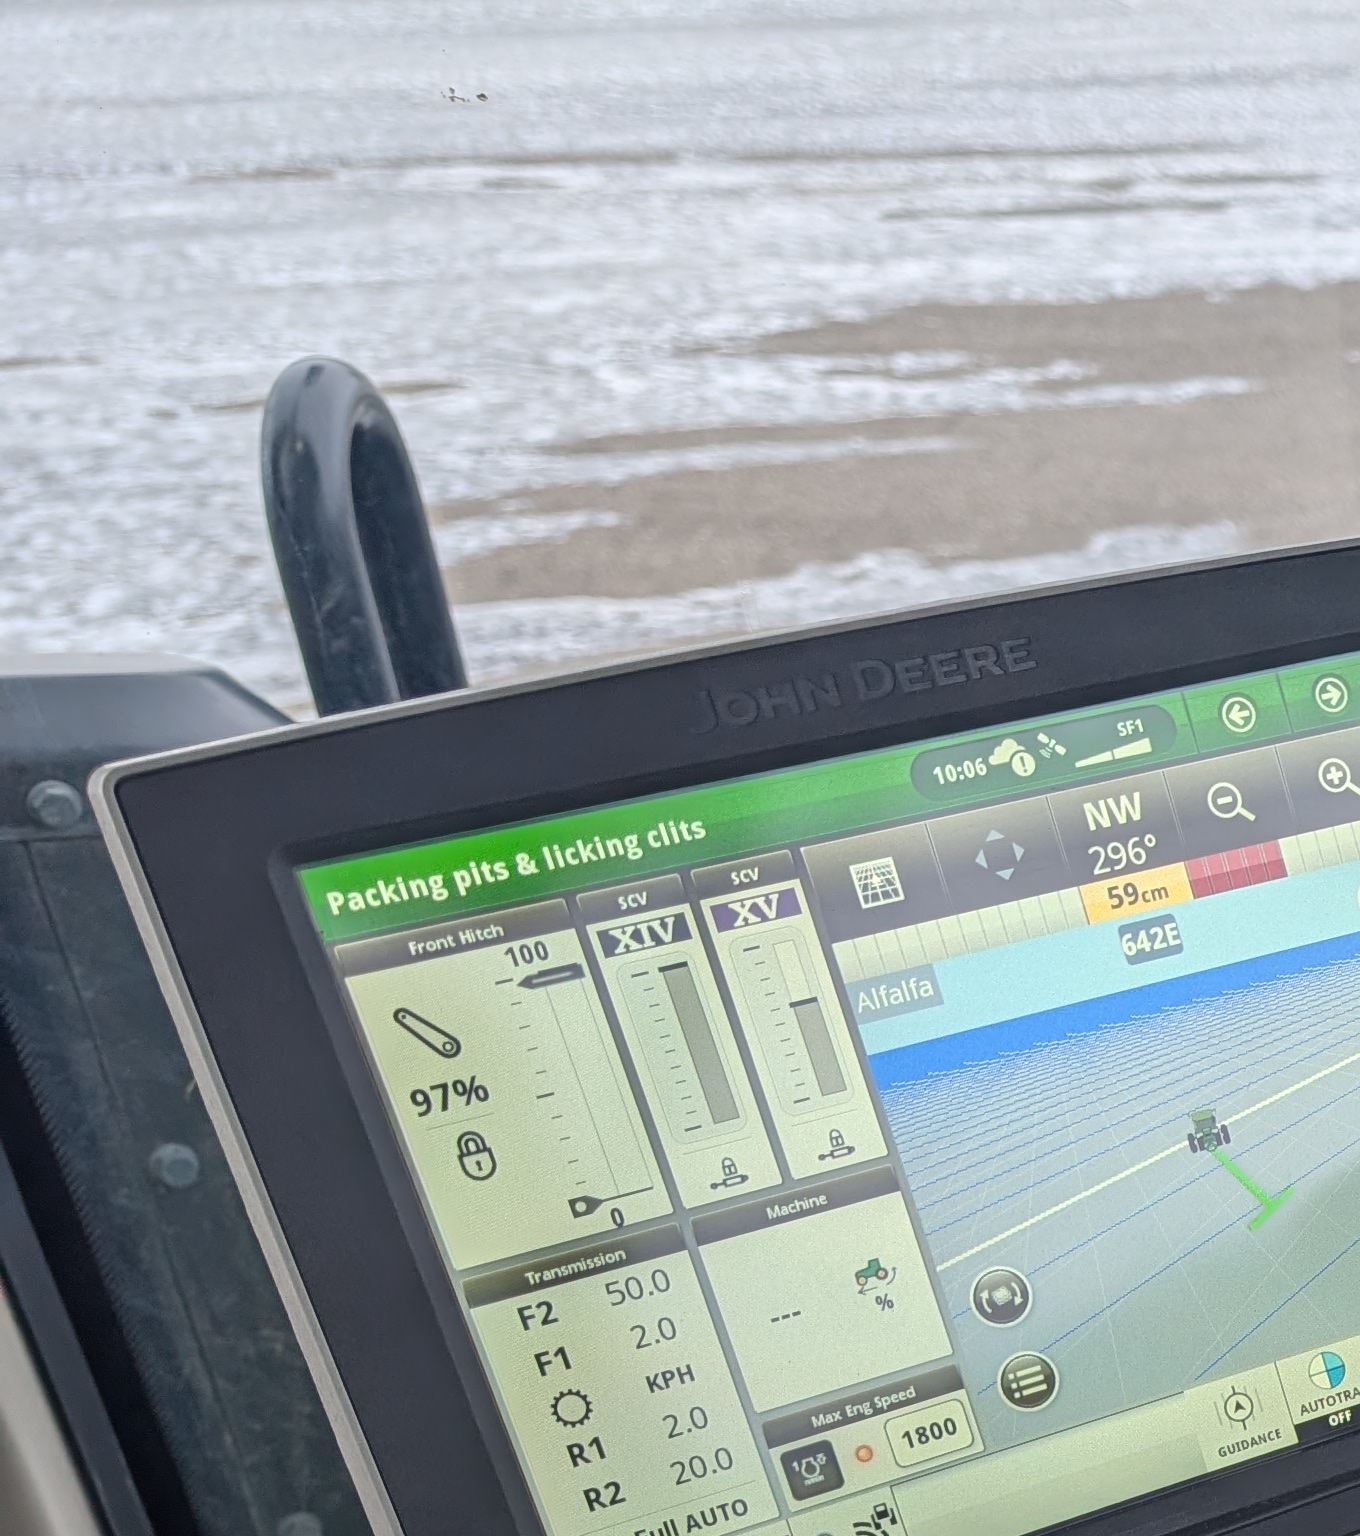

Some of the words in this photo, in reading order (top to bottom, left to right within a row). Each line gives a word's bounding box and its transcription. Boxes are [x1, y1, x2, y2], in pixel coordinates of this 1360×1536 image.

[694, 673, 842, 733] JOHN
[853, 636, 1037, 701] DEERE
[1117, 719, 1145, 738] SF1
[932, 757, 987, 785] 10:06
[1082, 792, 1143, 832] NW
[327, 873, 448, 916] Packing
[453, 859, 510, 895] pits
[516, 853, 539, 875] &
[542, 836, 643, 870] licking
[648, 818, 707, 849] clits
[731, 867, 759, 885] SCV
[618, 892, 648, 910] SCV
[728, 892, 780, 928] XV
[409, 933, 455, 957] Front
[459, 924, 505, 946] Hitch
[608, 916, 675, 955] XIV
[1120, 923, 1182, 958] 642E
[504, 940, 549, 968] 100
[857, 977, 935, 1014] Alfalfa
[409, 1074, 491, 1118] 97%
[609, 1208, 626, 1227] 0
[766, 1191, 828, 1220] Machine
[524, 1247, 627, 1287] Transmission
[516, 1301, 560, 1331] F2
[605, 1269, 672, 1307] 50.0
[534, 1346, 573, 1377] F1
[629, 1316, 678, 1349] 2.0
[645, 1363, 696, 1394] KPH
[811, 1409, 843, 1430] Max
[846, 1397, 874, 1420] Eng
[874, 1386, 916, 1416] Speed
[1328, 1407, 1353, 1427] OFF
[566, 1436, 608, 1468] R1
[662, 1406, 709, 1439] 2.0
[901, 1417, 958, 1451] 1800
[1217, 1427, 1283, 1459] GUIDANCE
[583, 1481, 627, 1513] R2
[670, 1447, 734, 1486] 20.0
[685, 1498, 749, 1534] AUTO
